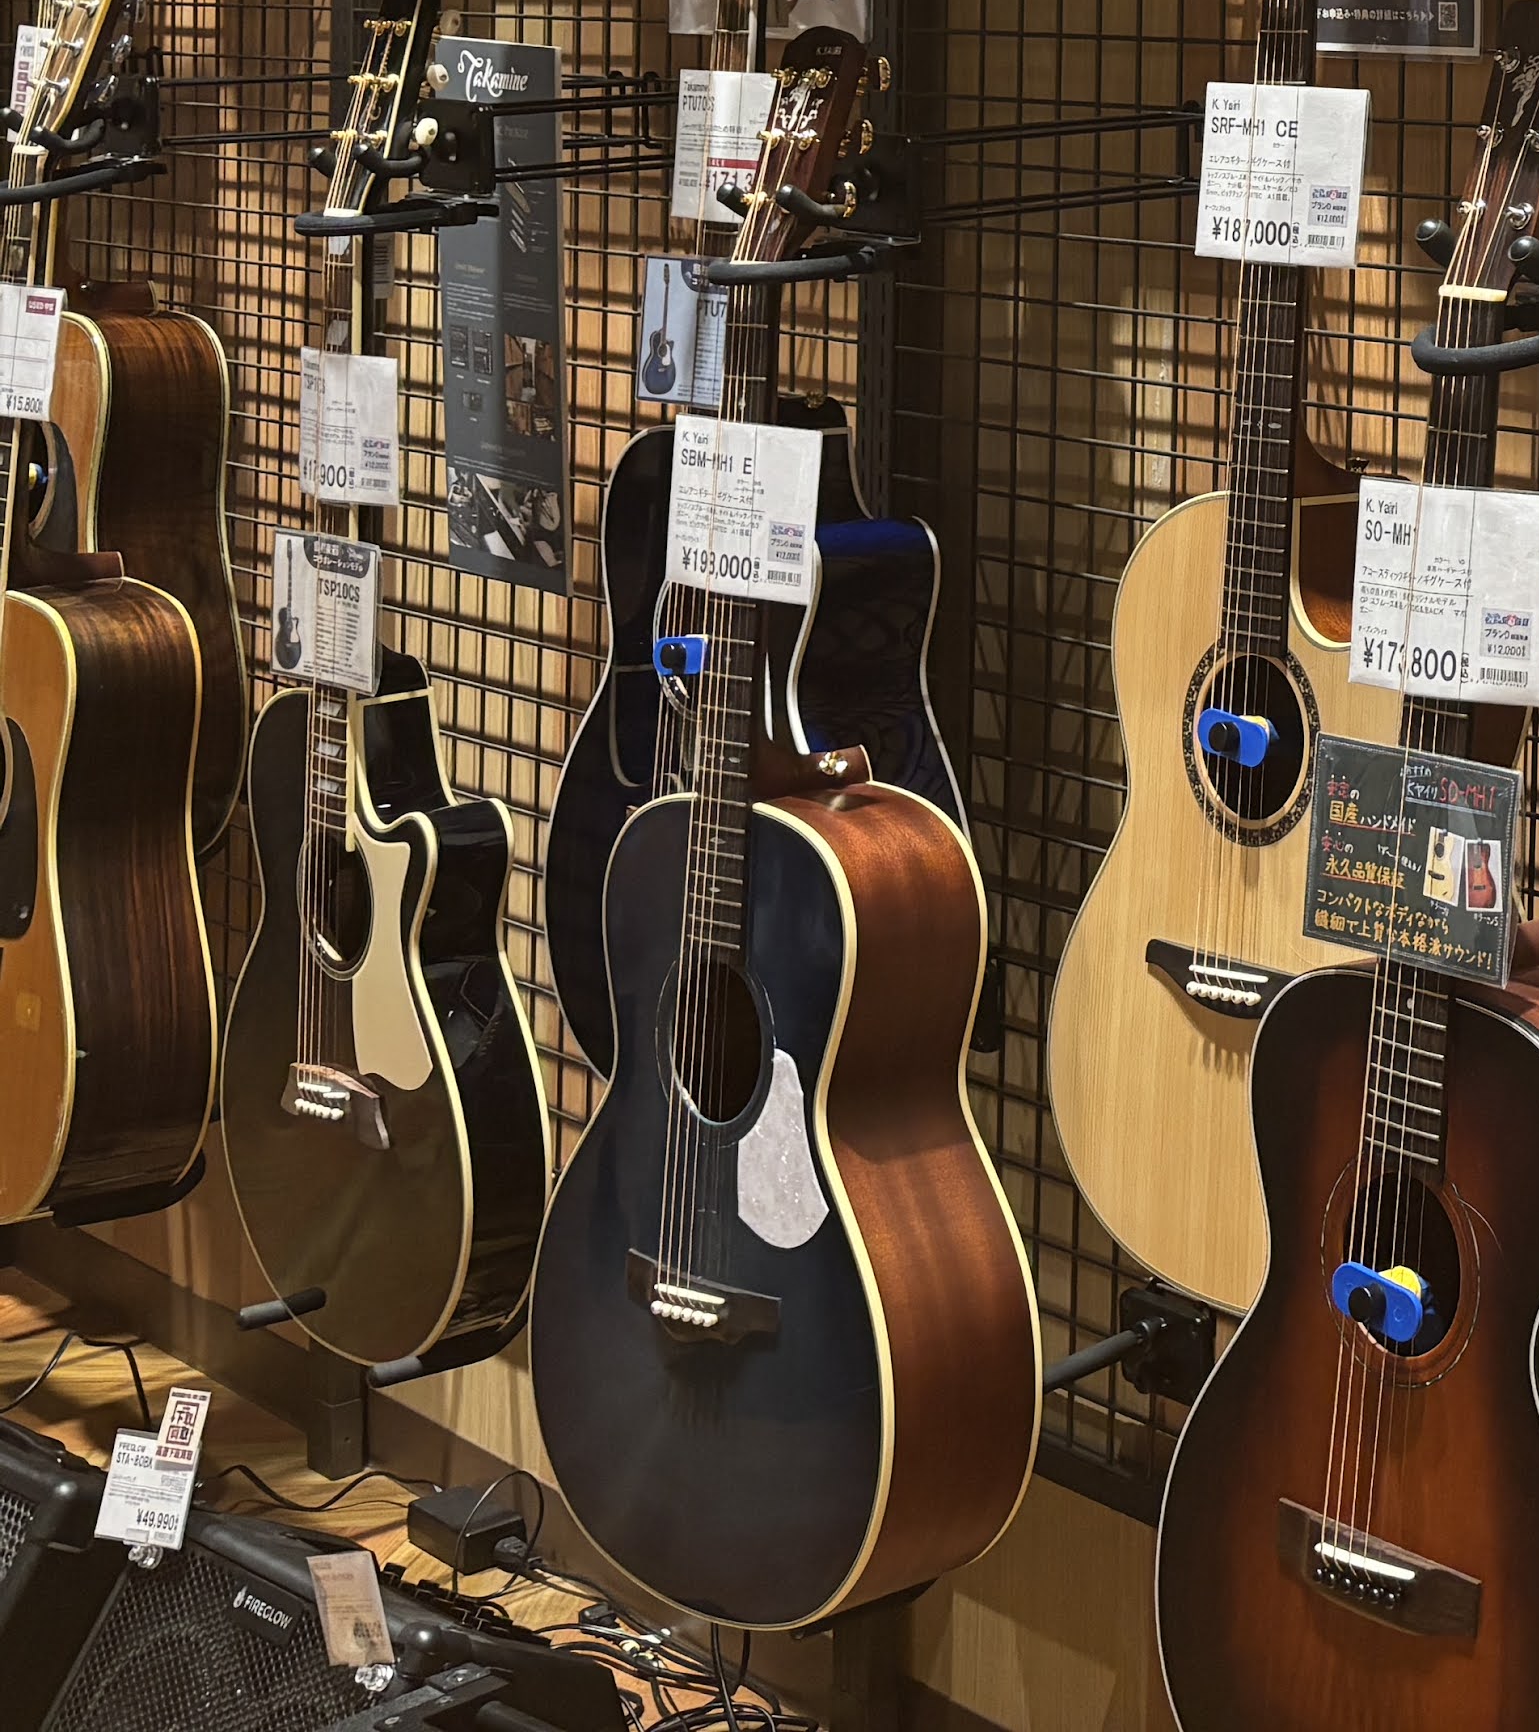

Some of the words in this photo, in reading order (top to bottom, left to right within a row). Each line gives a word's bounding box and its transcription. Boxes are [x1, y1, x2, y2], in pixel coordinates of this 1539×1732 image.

[458, 50, 528, 102] Takamine
[1276, 120, 1299, 138] CE
[743, 457, 752, 474] E
[1365, 520, 1417, 547] SO-MH
[243, 1594, 293, 1630] FIREGLOW
